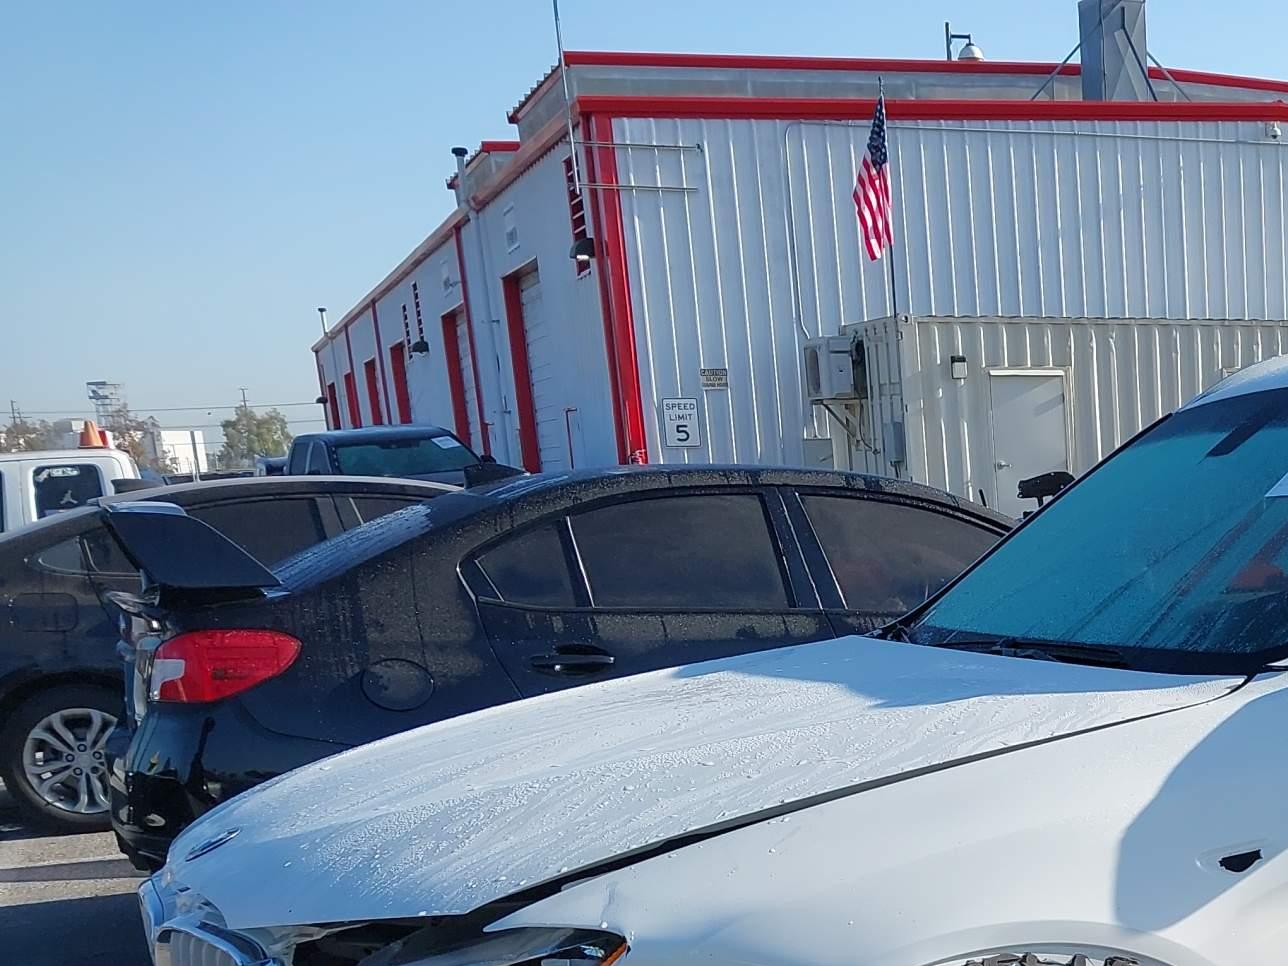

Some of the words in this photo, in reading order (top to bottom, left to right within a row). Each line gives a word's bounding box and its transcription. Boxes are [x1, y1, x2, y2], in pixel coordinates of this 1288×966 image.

[665, 403, 695, 411] SPEED
[669, 413, 693, 421] LIMIT
[676, 425, 690, 442] 5
